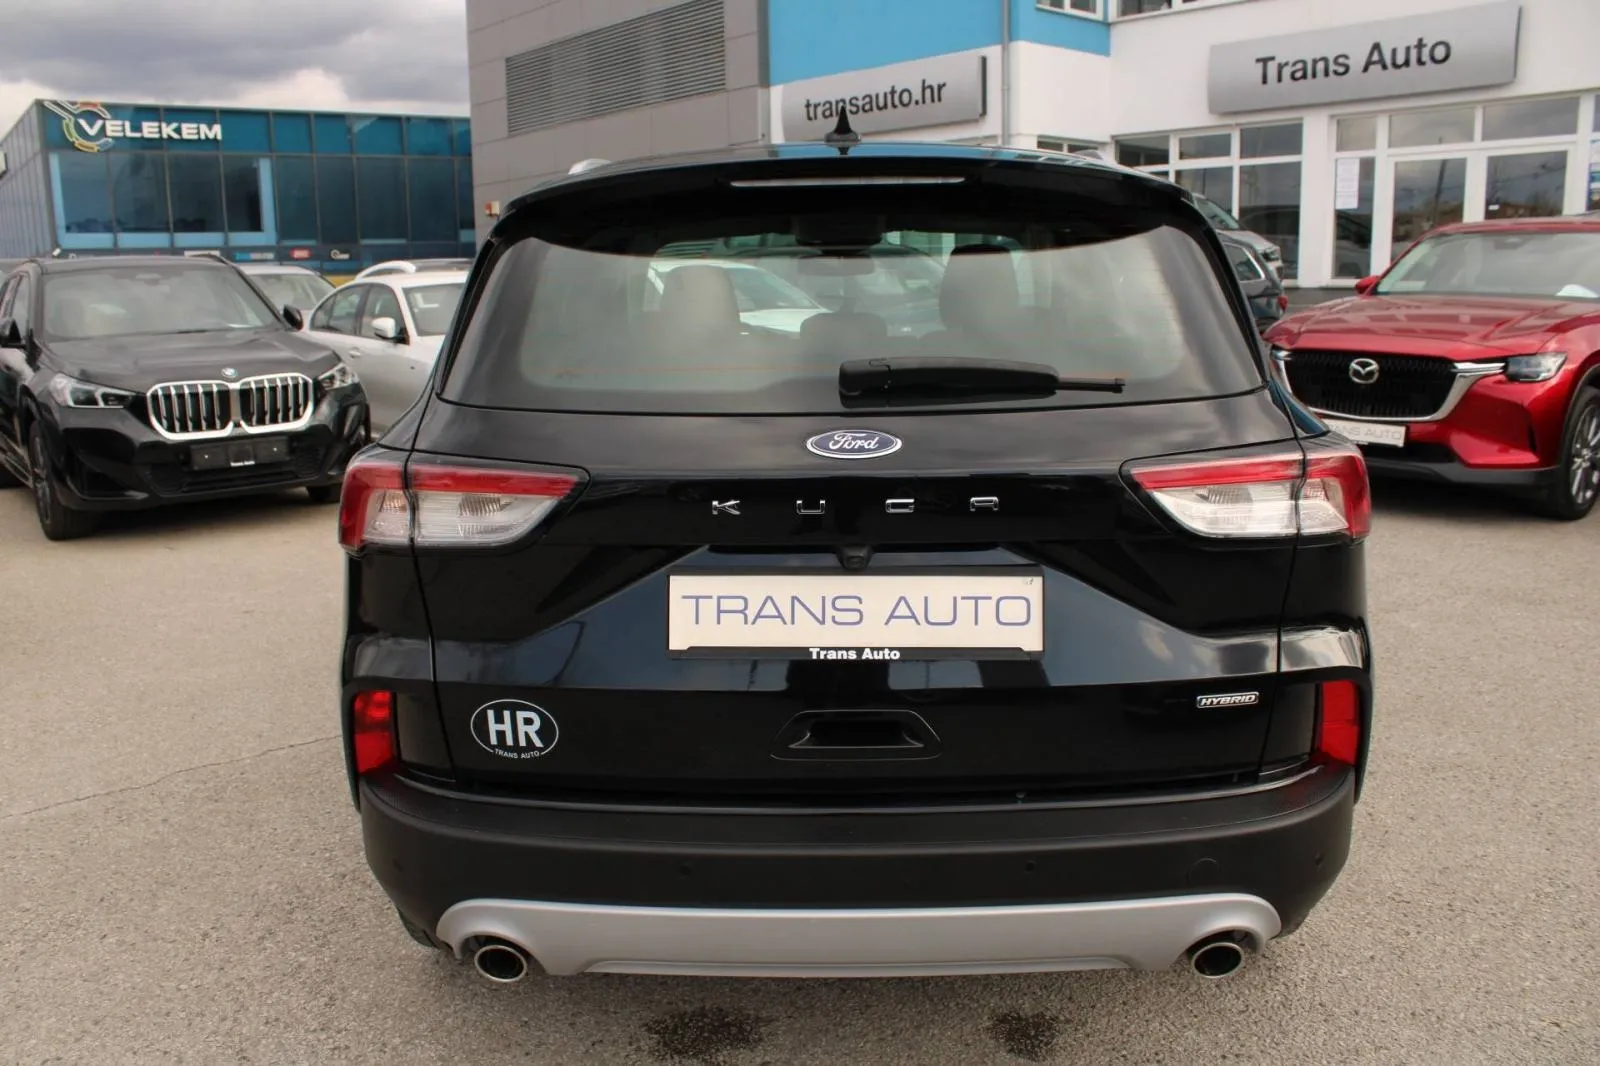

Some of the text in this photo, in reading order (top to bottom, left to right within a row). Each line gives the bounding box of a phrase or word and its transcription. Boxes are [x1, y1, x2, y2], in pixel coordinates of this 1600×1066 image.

[1255, 37, 1452, 85] Trans Auto
[804, 79, 946, 121] transauto.hr
[77, 118, 222, 140] VELEKEM
[829, 433, 880, 449] Ford
[711, 496, 999, 515] KUGA
[681, 595, 1031, 626] TRANS AUTO
[809, 647, 900, 659] Trans Auto
[1201, 695, 1256, 705] HYBRID
[487, 709, 544, 747] HR
[495, 748, 540, 759] TRANS AUTO
